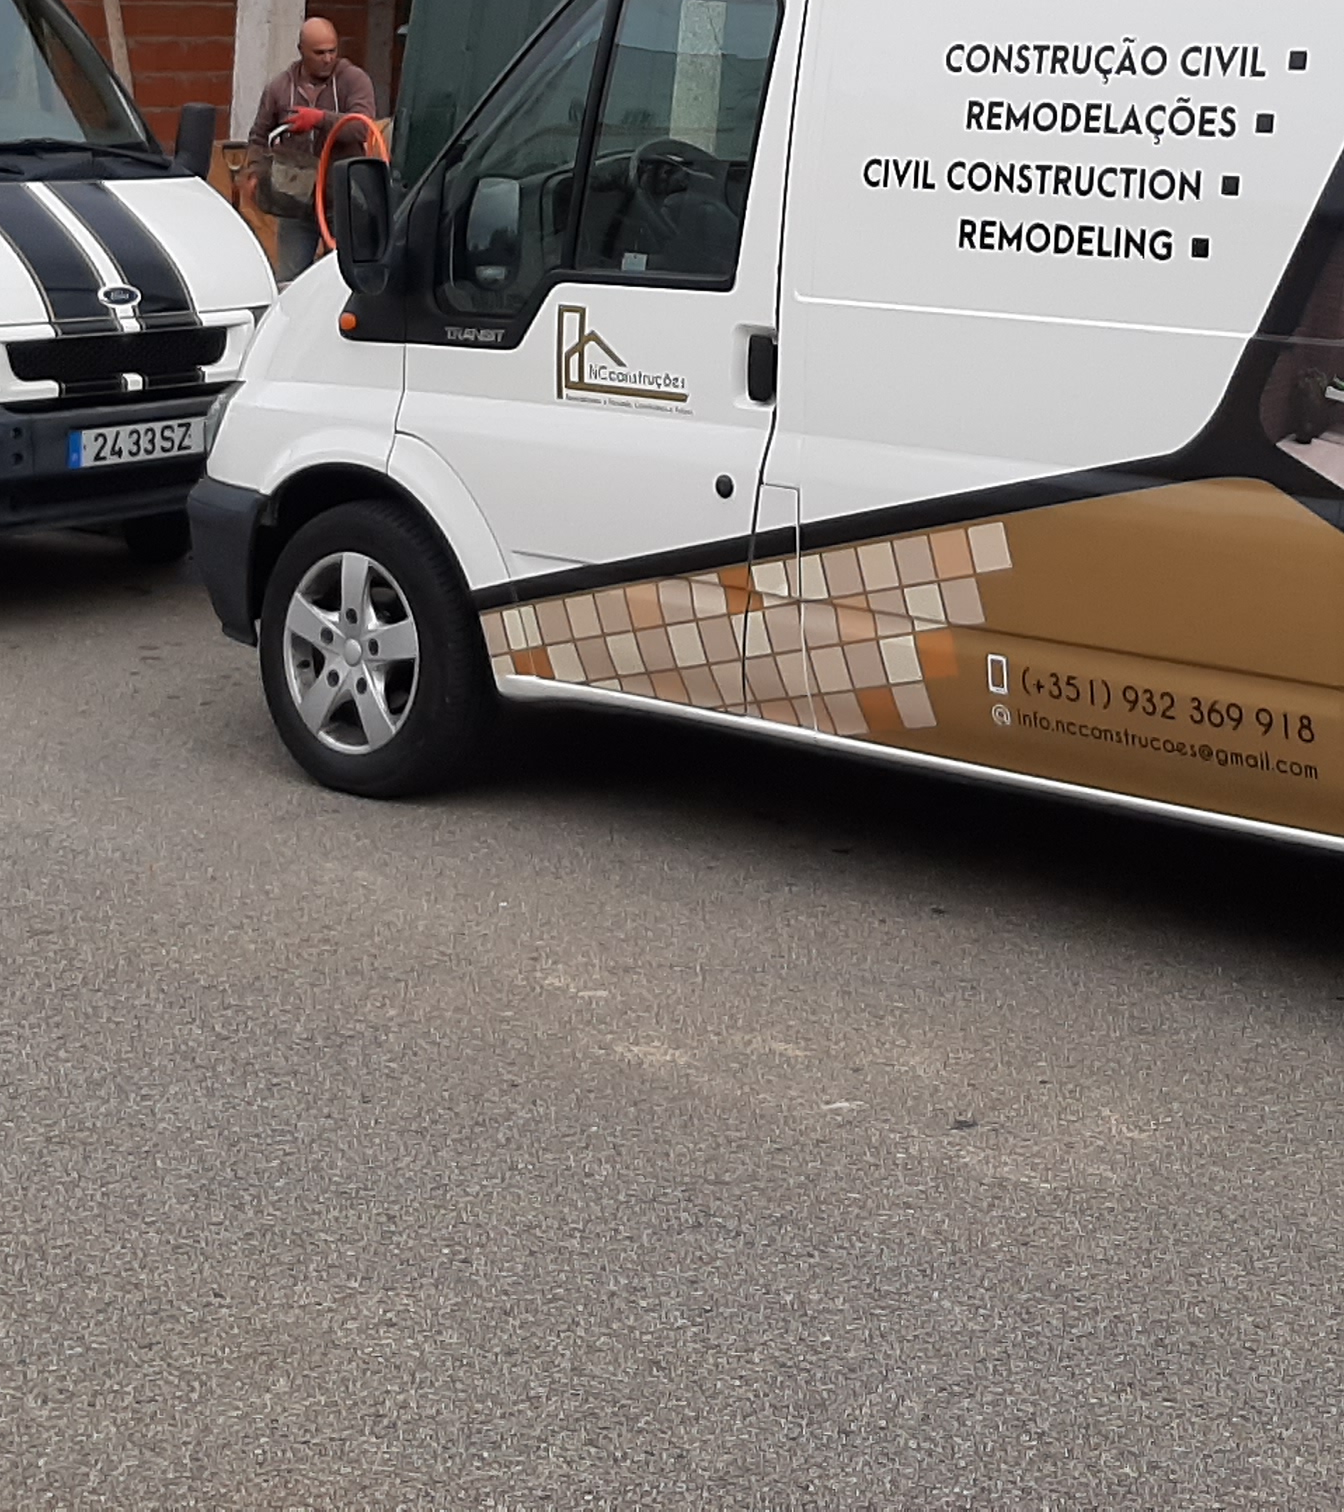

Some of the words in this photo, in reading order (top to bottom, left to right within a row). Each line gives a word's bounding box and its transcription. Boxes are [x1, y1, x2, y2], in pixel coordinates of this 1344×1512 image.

[945, 36, 1168, 84] CONSTRUÇÃO
[1179, 46, 1267, 78] CIVIL
[965, 97, 1237, 145] REMODELAÇÕES
[862, 158, 936, 191] CIVIL
[946, 161, 1203, 201] CONSTRUCTION
[957, 218, 1173, 261] REMODELING
[1021, 666, 1111, 710] (+351)
[1122, 684, 1176, 720] 932
[1189, 696, 1244, 731] 369
[1255, 707, 1316, 744] 918
